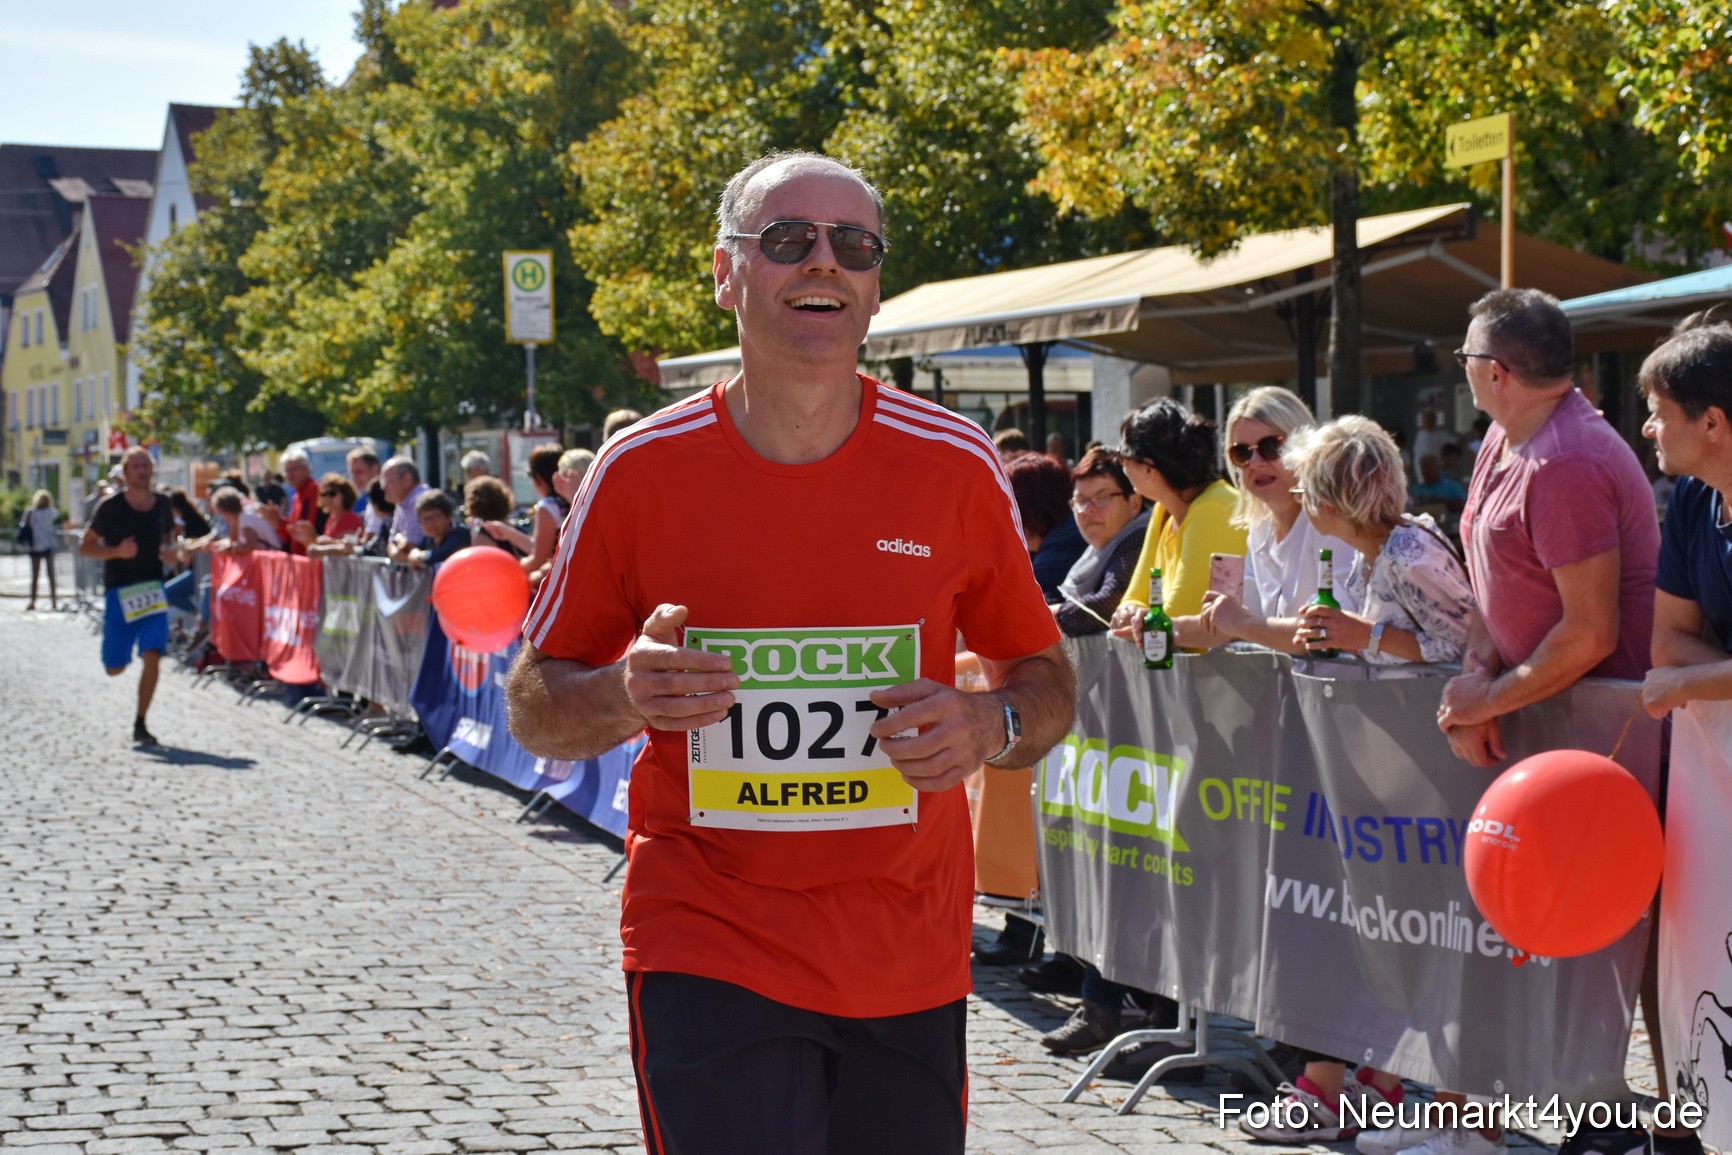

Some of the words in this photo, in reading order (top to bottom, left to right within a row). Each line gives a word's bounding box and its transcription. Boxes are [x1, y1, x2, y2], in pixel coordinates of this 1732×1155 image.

[876, 538, 931, 558] adidas
[702, 636, 899, 682] BOCK
[690, 727, 701, 764] ZEITGE
[719, 700, 890, 761] 1027
[737, 780, 869, 807] ALFRED
